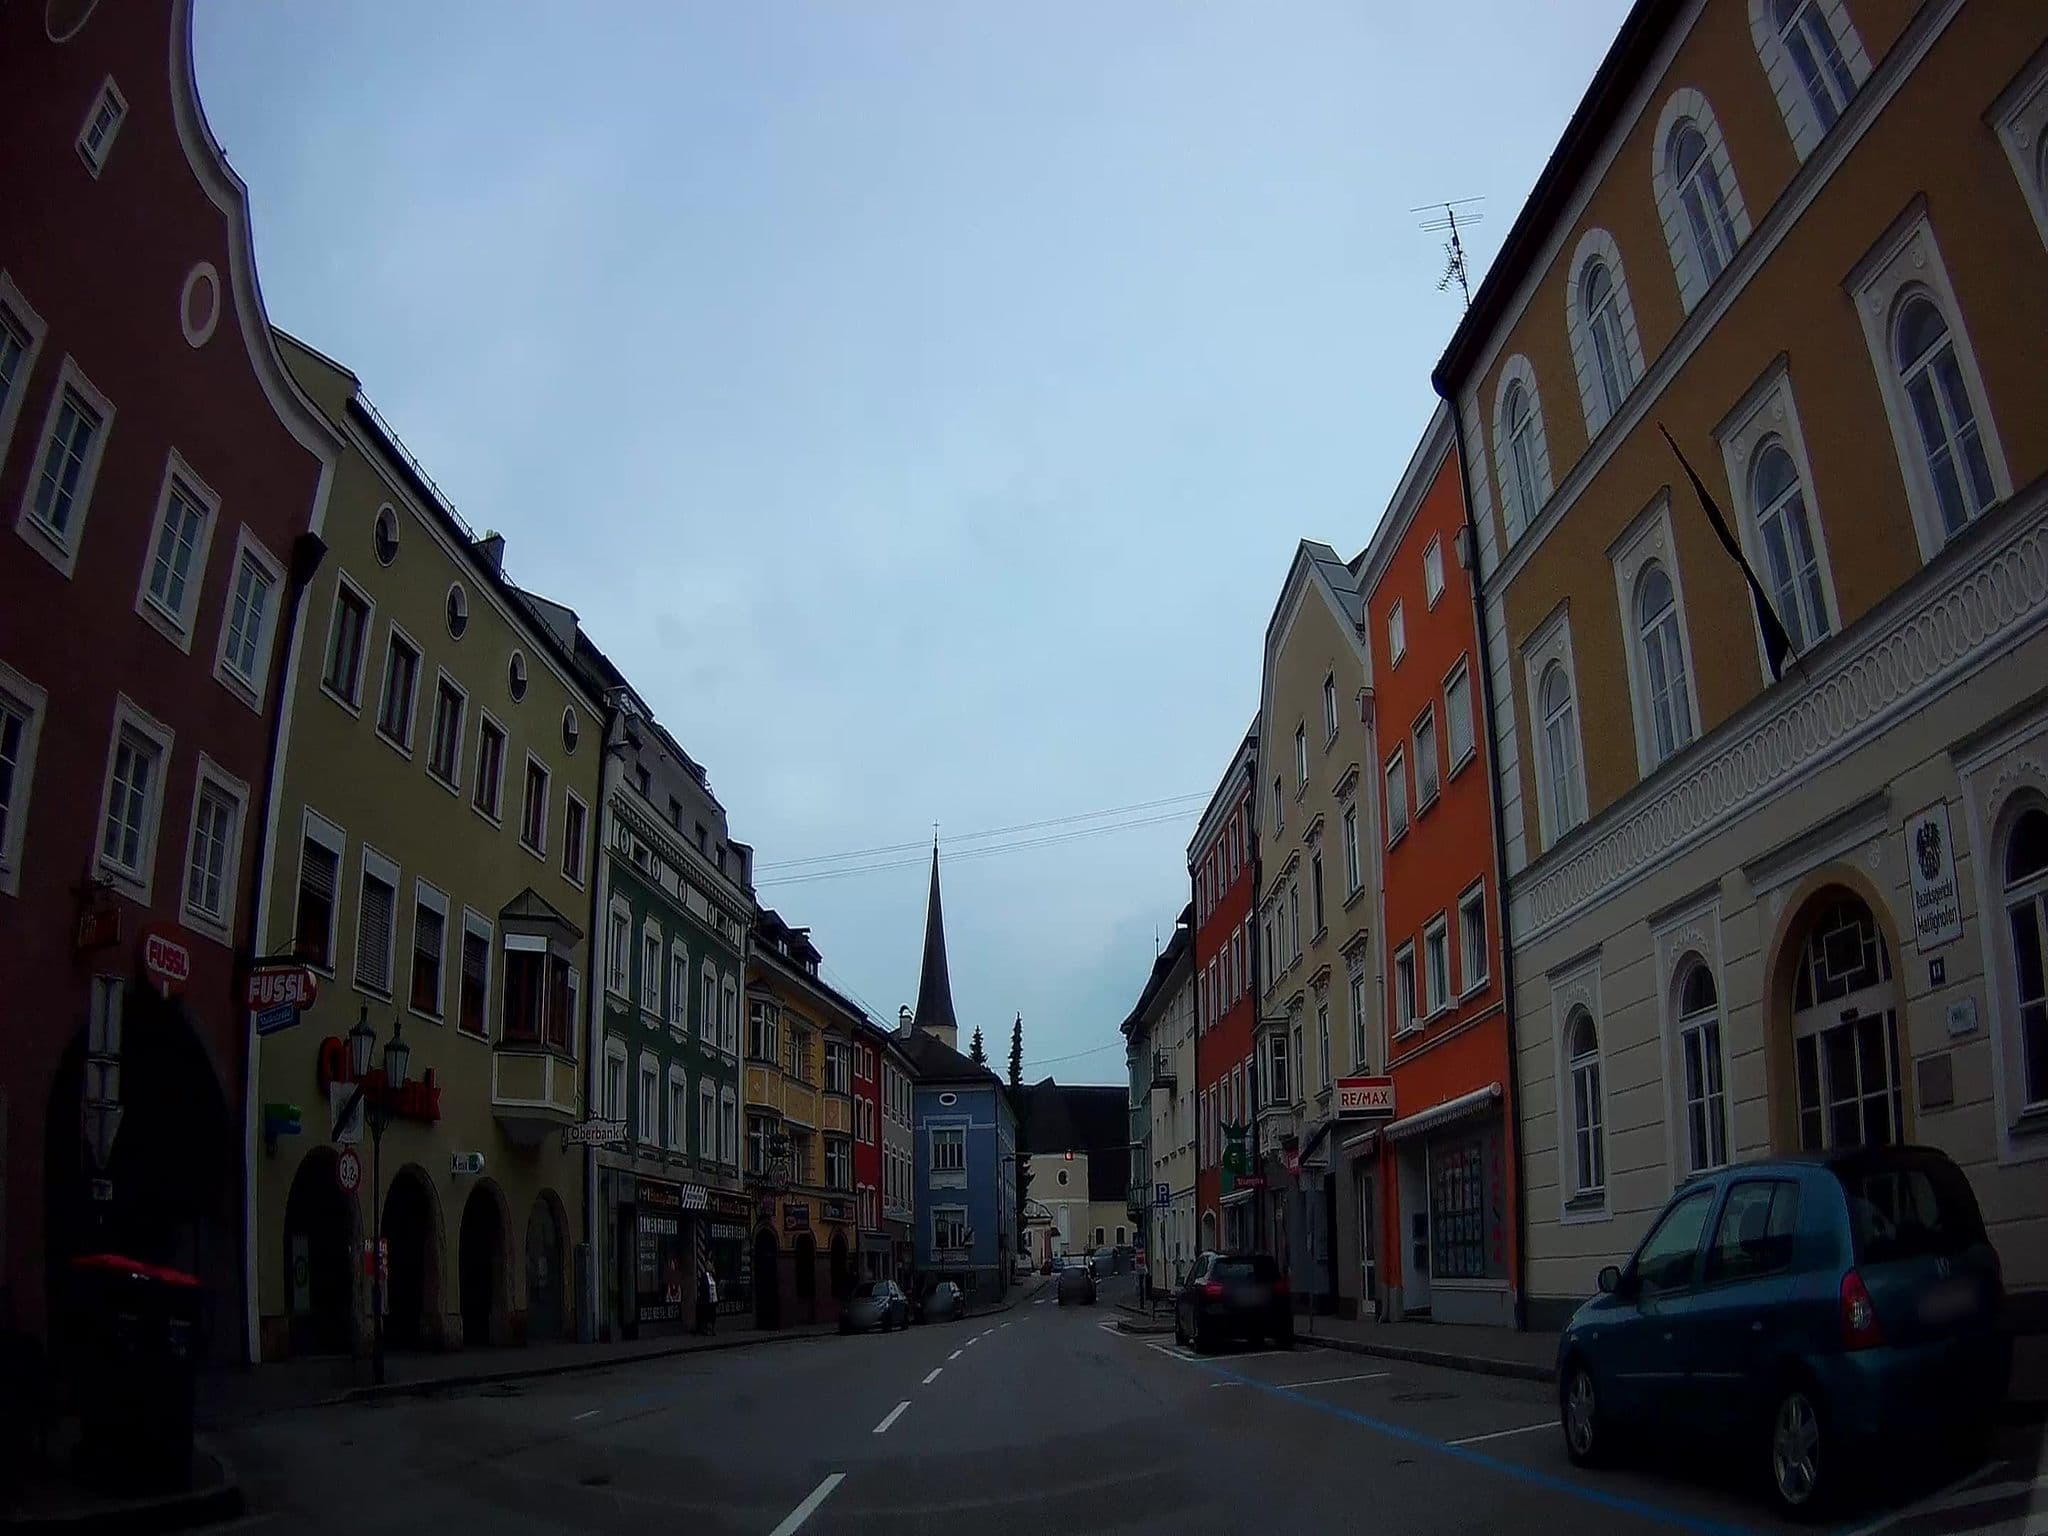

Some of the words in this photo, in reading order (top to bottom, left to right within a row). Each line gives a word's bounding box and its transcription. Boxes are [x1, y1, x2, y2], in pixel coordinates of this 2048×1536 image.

[1915, 879, 1953, 908] Bezirksgericht
[1916, 905, 1957, 935] Mattighofen
[149, 939, 187, 977] FUSSL
[249, 973, 307, 1004] FUSSL
[1341, 1091, 1388, 1106] RE/MAX
[571, 1125, 619, 1140] Oberbank
